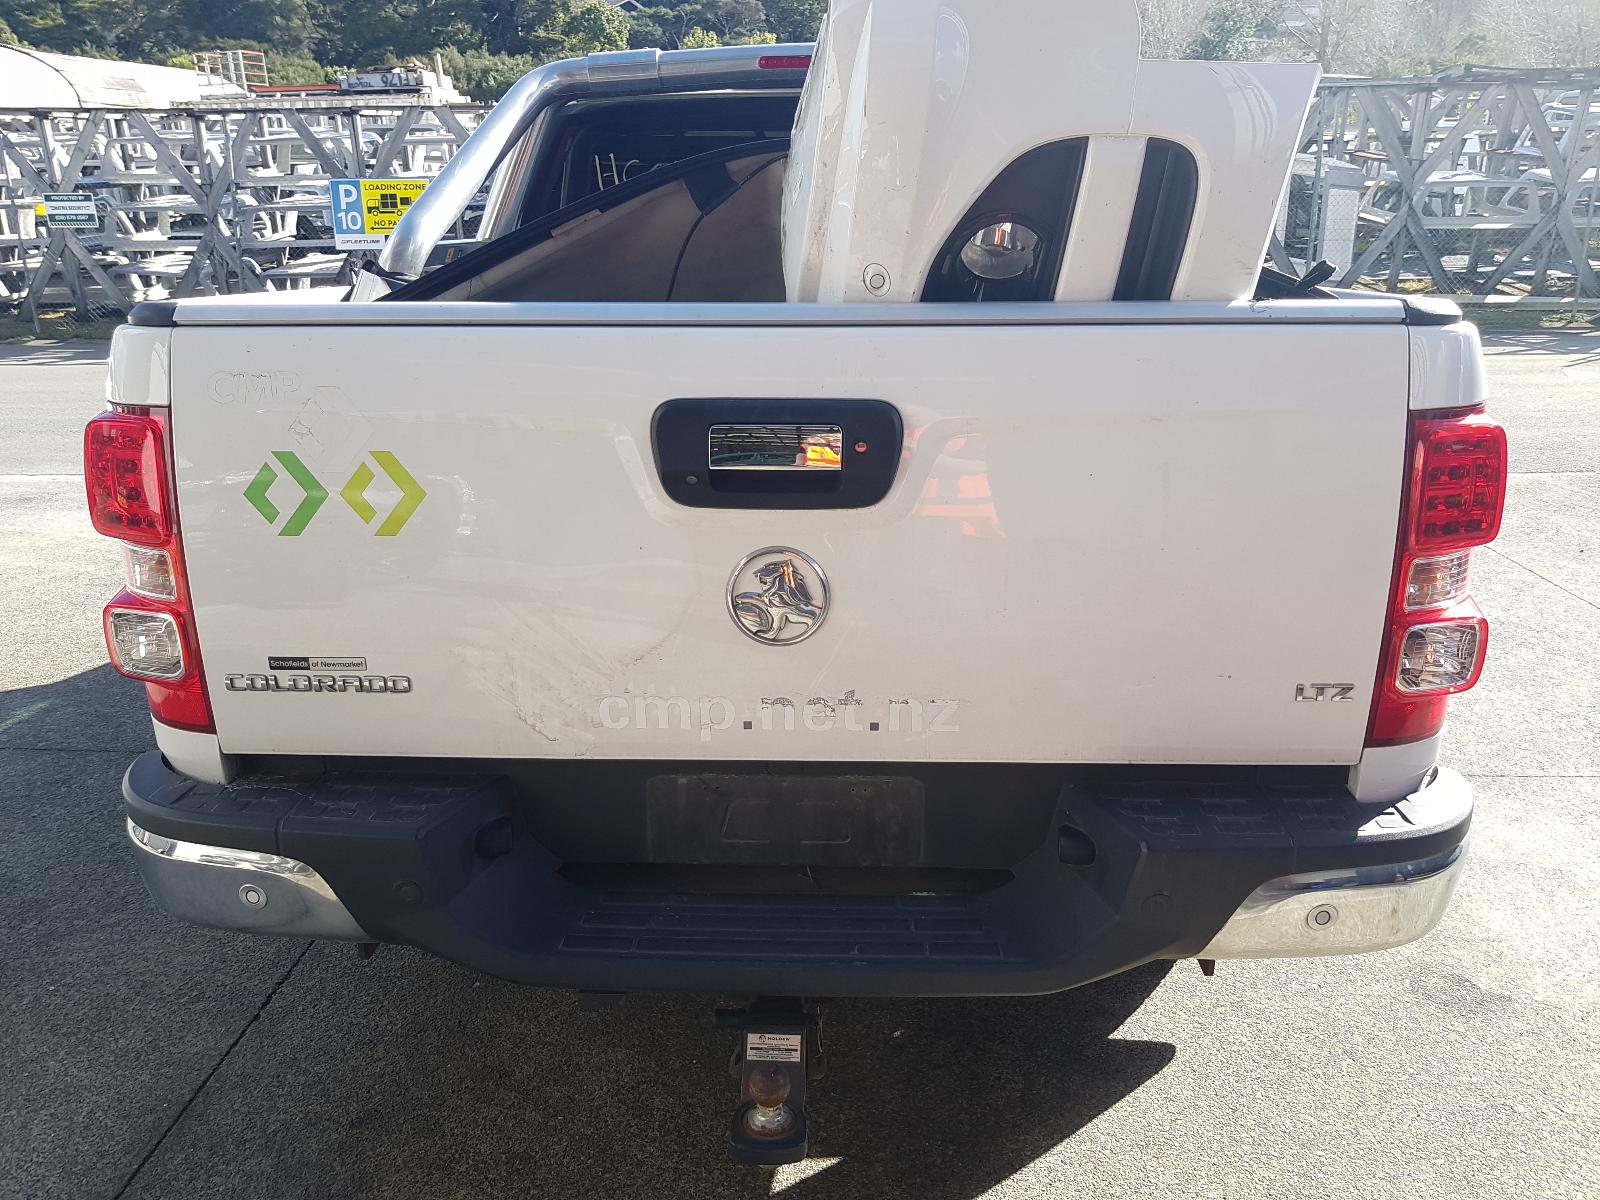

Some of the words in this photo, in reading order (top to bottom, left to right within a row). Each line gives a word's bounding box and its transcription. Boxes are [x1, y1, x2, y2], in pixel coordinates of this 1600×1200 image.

[338, 184, 358, 210] P
[364, 183, 402, 191] LOADING
[403, 183, 426, 191] ZONE
[337, 211, 362, 230] 10
[270, 659, 309, 668] Schofields
[311, 659, 320, 668] of
[320, 660, 364, 668] Newmarket
[224, 673, 412, 693] COLORADO
[1295, 682, 1355, 702] LTZ
[599, 689, 961, 742] cmp.net.nz
